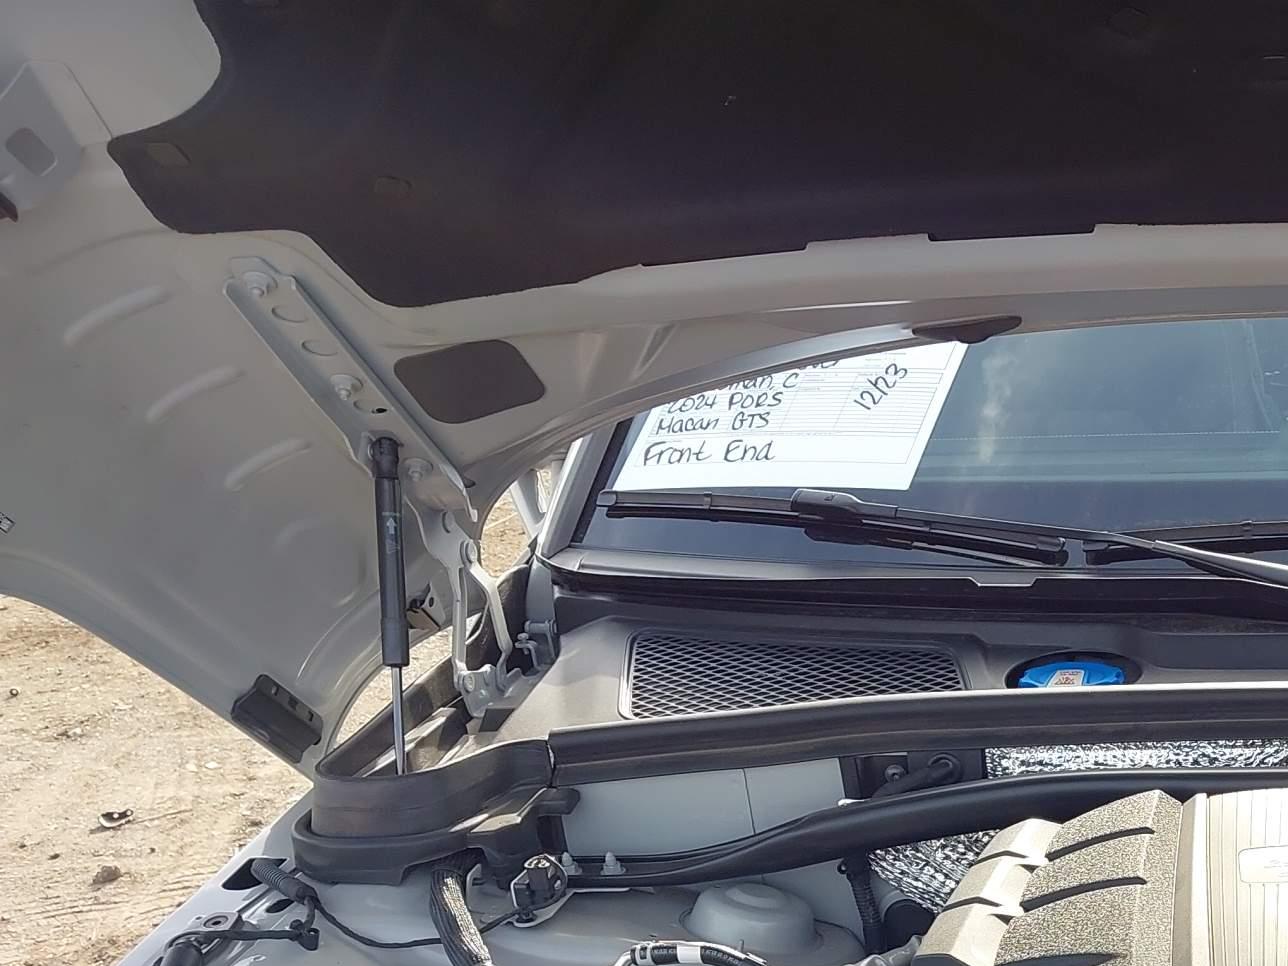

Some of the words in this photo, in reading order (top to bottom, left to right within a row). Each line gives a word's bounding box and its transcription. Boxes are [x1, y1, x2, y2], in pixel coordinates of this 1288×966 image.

[655, 414, 720, 435] Macan
[731, 411, 771, 431] GTS
[643, 439, 713, 466] Front
[723, 439, 776, 463] End
